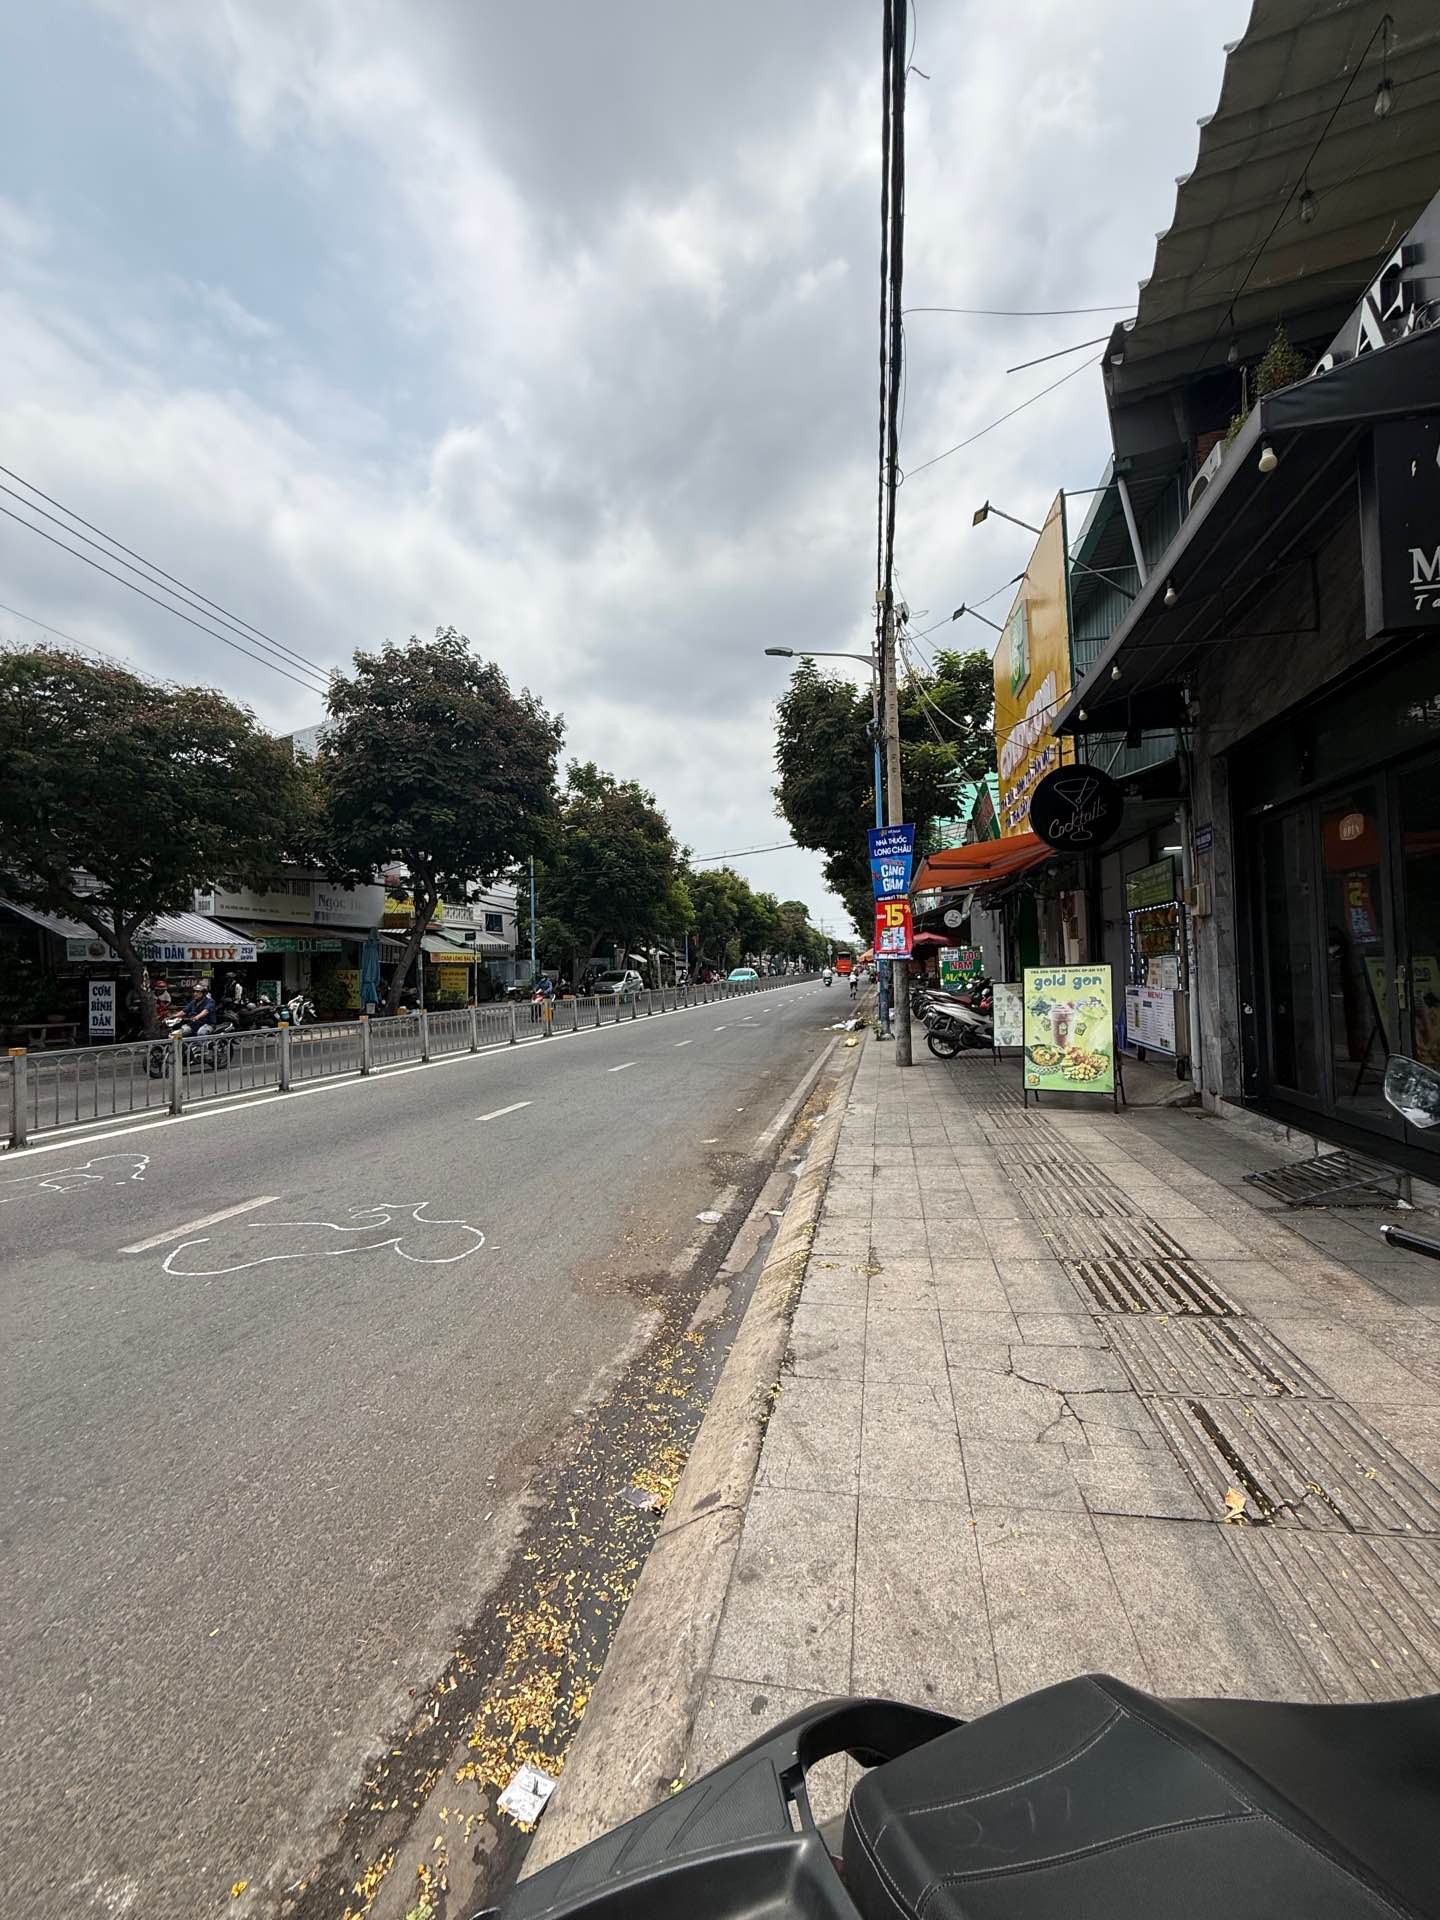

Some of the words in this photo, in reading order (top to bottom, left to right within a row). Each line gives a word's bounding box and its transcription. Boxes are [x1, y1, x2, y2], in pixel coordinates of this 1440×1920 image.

[888, 835, 908, 845] THUỐC
[873, 847, 892, 857] LONG
[891, 843, 912, 854] CHÂU
[164, 944, 184, 959] DÂN
[1034, 974, 1066, 991] gold
[1072, 976, 1102, 990] gon
